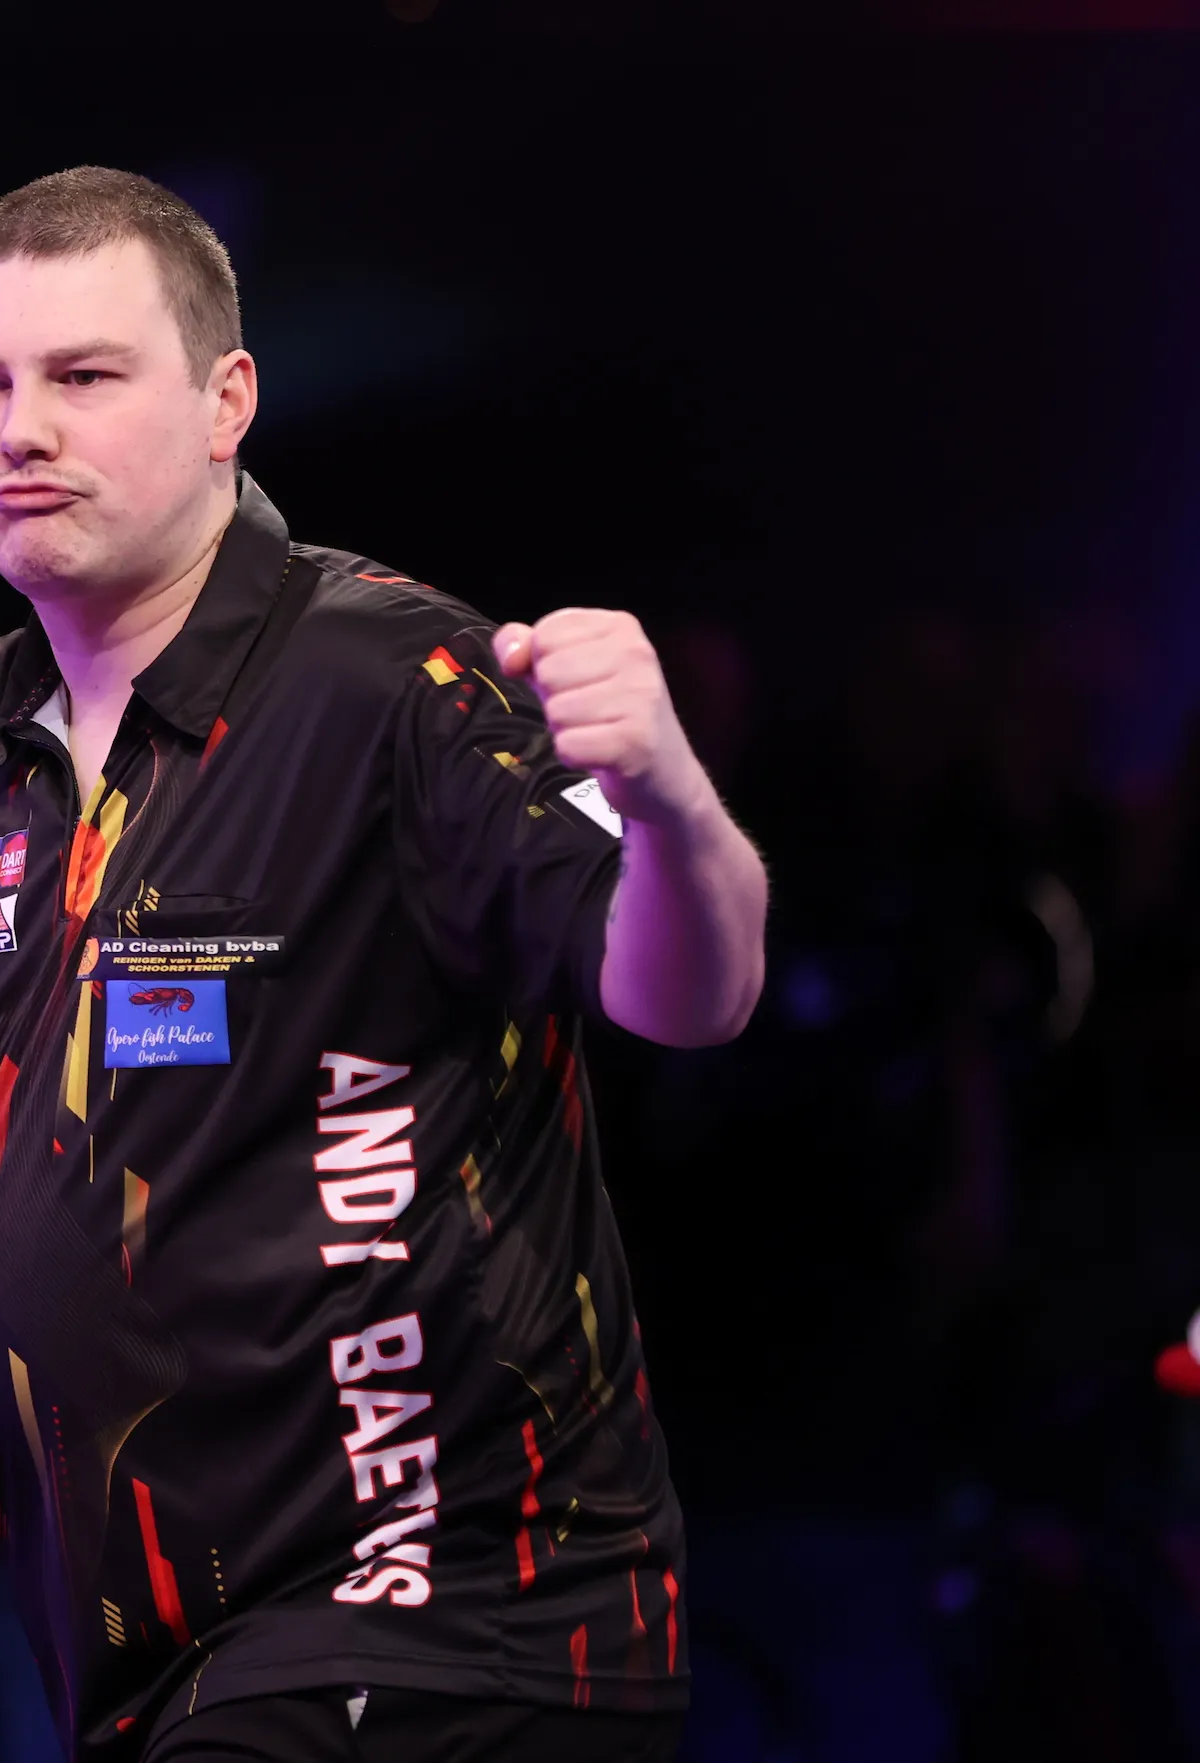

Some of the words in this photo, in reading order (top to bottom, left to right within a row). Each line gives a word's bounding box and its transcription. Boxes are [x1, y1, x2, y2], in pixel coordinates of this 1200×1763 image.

[1, 848, 27, 870] DART
[0, 866, 23, 878] CONNECT
[101, 942, 124, 953] AD
[129, 941, 219, 955] Cleaning
[226, 940, 280, 952] bvba
[113, 956, 167, 964] REINIGEN
[195, 956, 242, 964] DAKEN
[244, 955, 255, 963] &
[128, 964, 231, 972] SCHOORSTENEN
[141, 1024, 167, 1048] fish
[168, 1024, 215, 1045] Palace
[138, 1049, 180, 1064] Oostende
